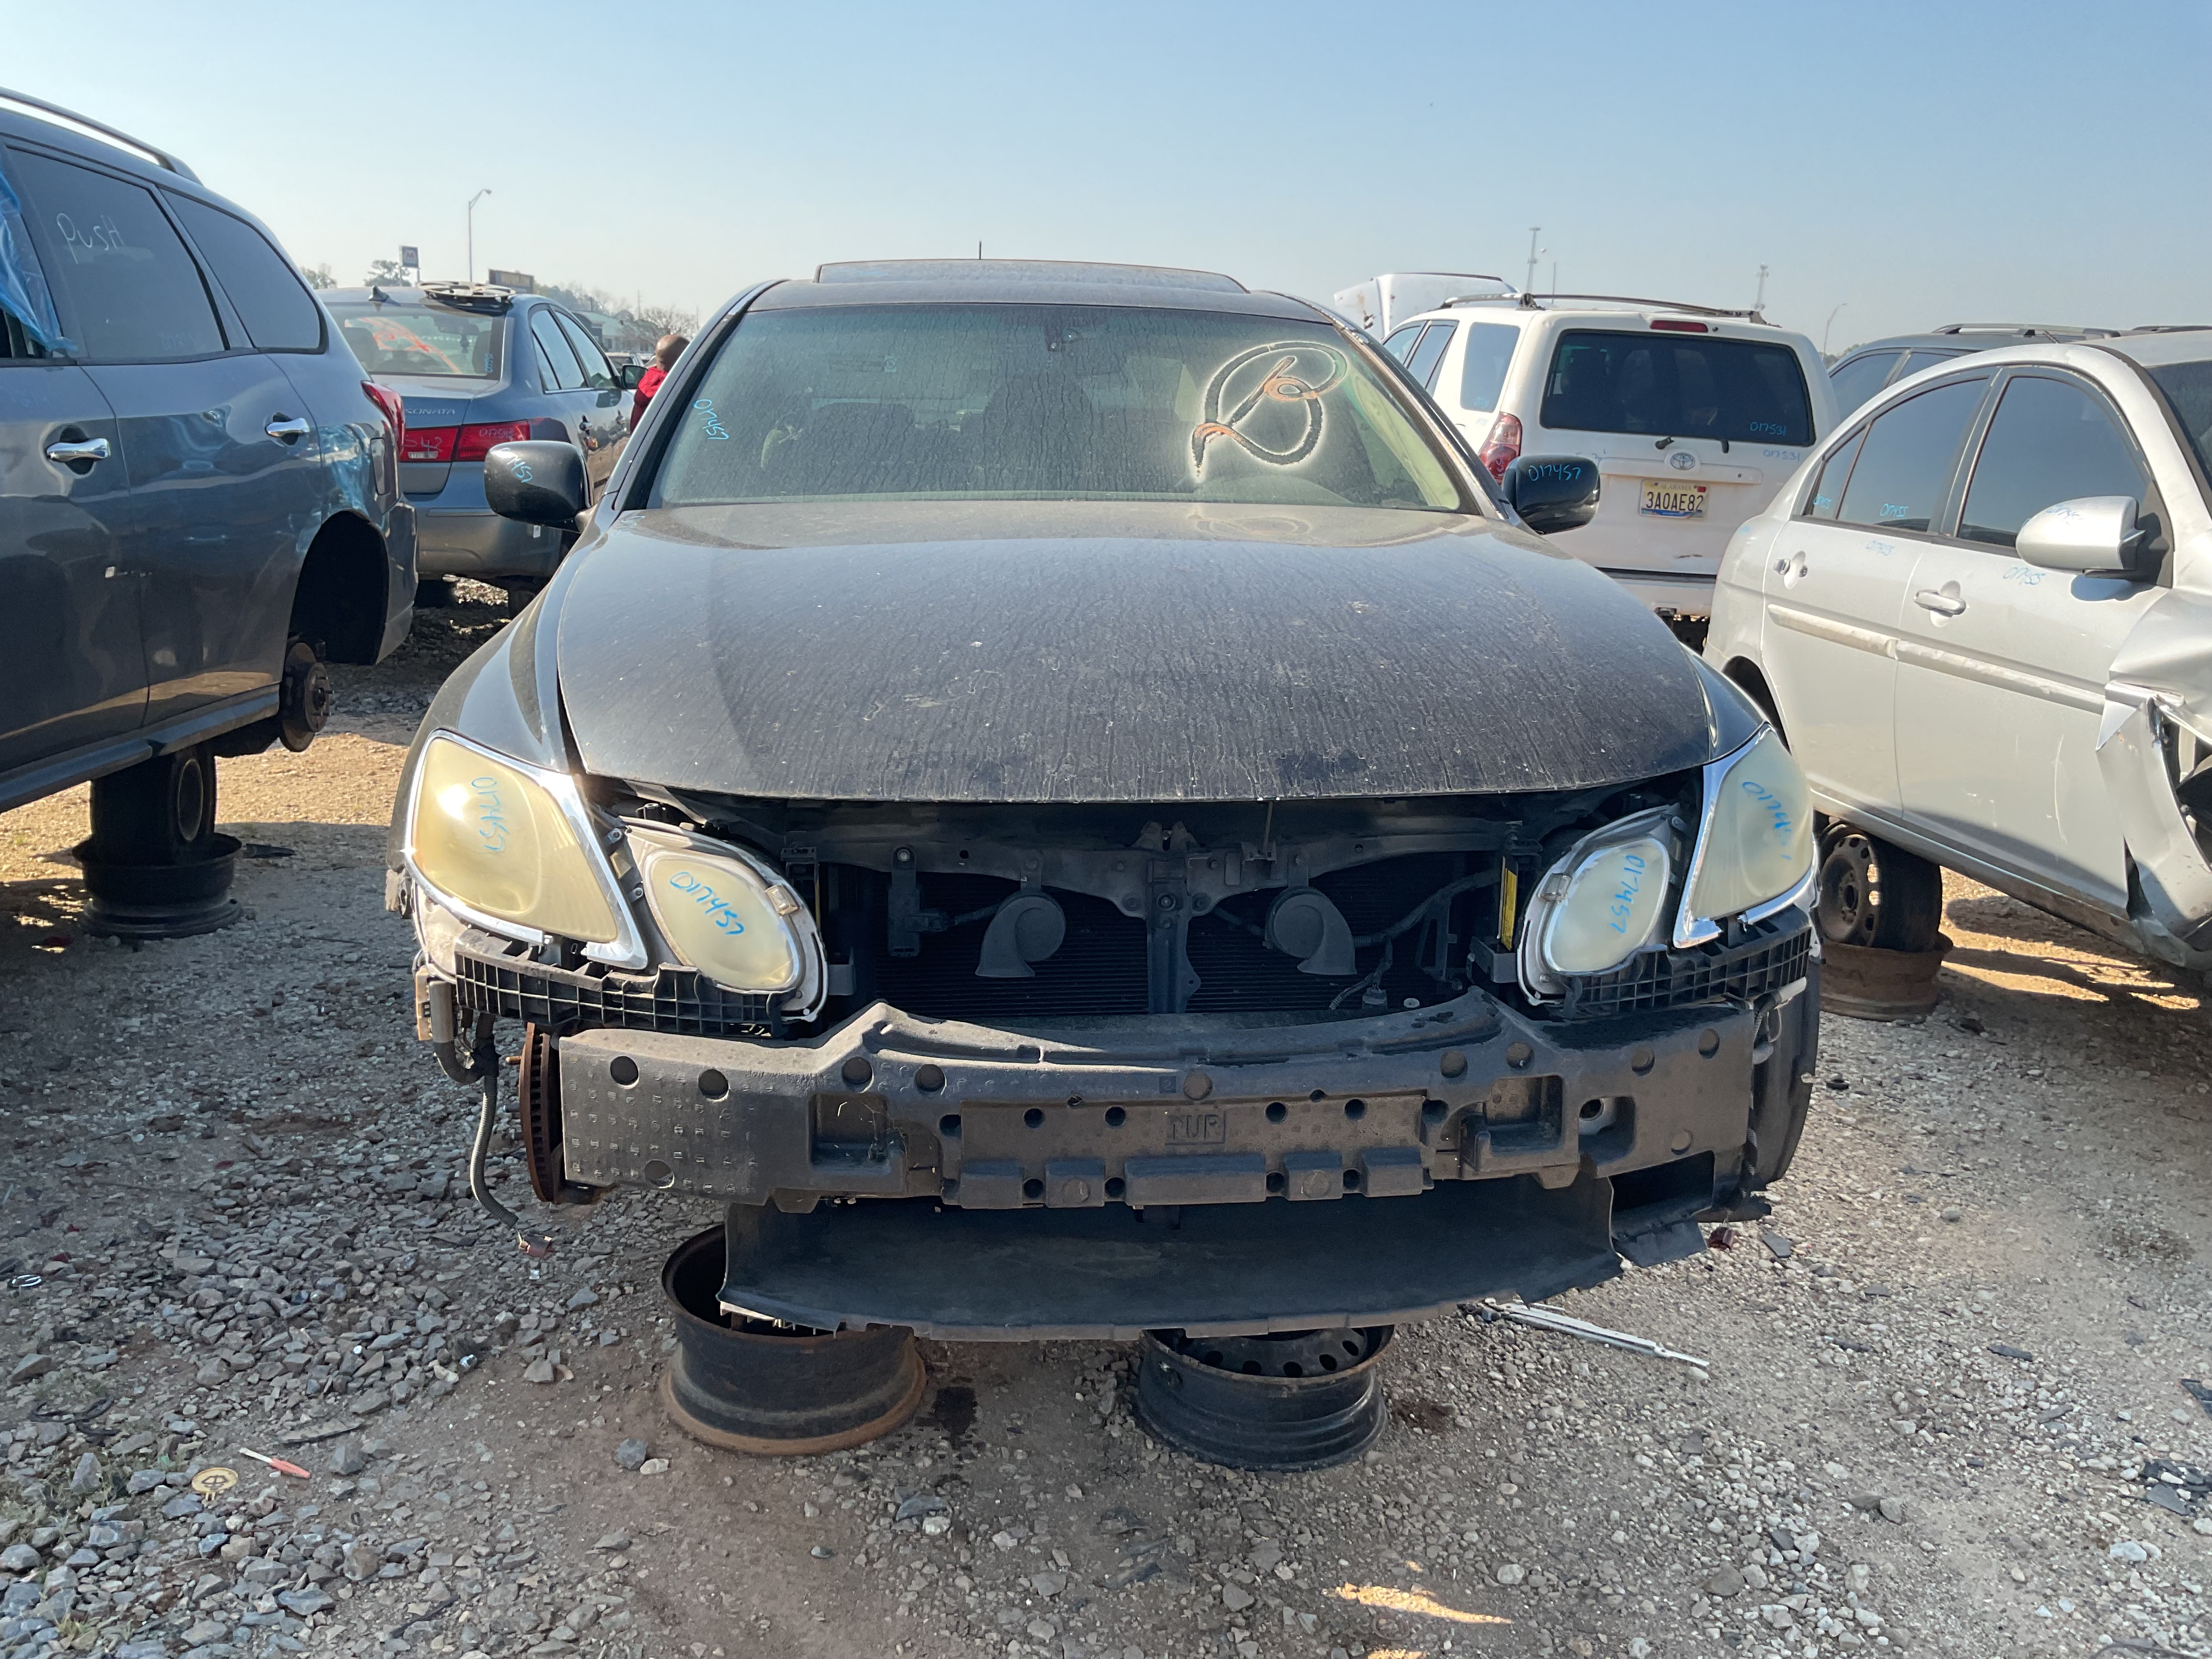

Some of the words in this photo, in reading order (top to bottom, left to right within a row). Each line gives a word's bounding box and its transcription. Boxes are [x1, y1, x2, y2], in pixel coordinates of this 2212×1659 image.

[1750, 421, 1787, 436] 017531
[1528, 464, 1581, 482] 017457
[1646, 491, 1704, 512] 3A0AE82
[471, 777, 510, 851] 017457
[670, 871, 744, 935] 017457
[1610, 854, 1645, 934] 017457
